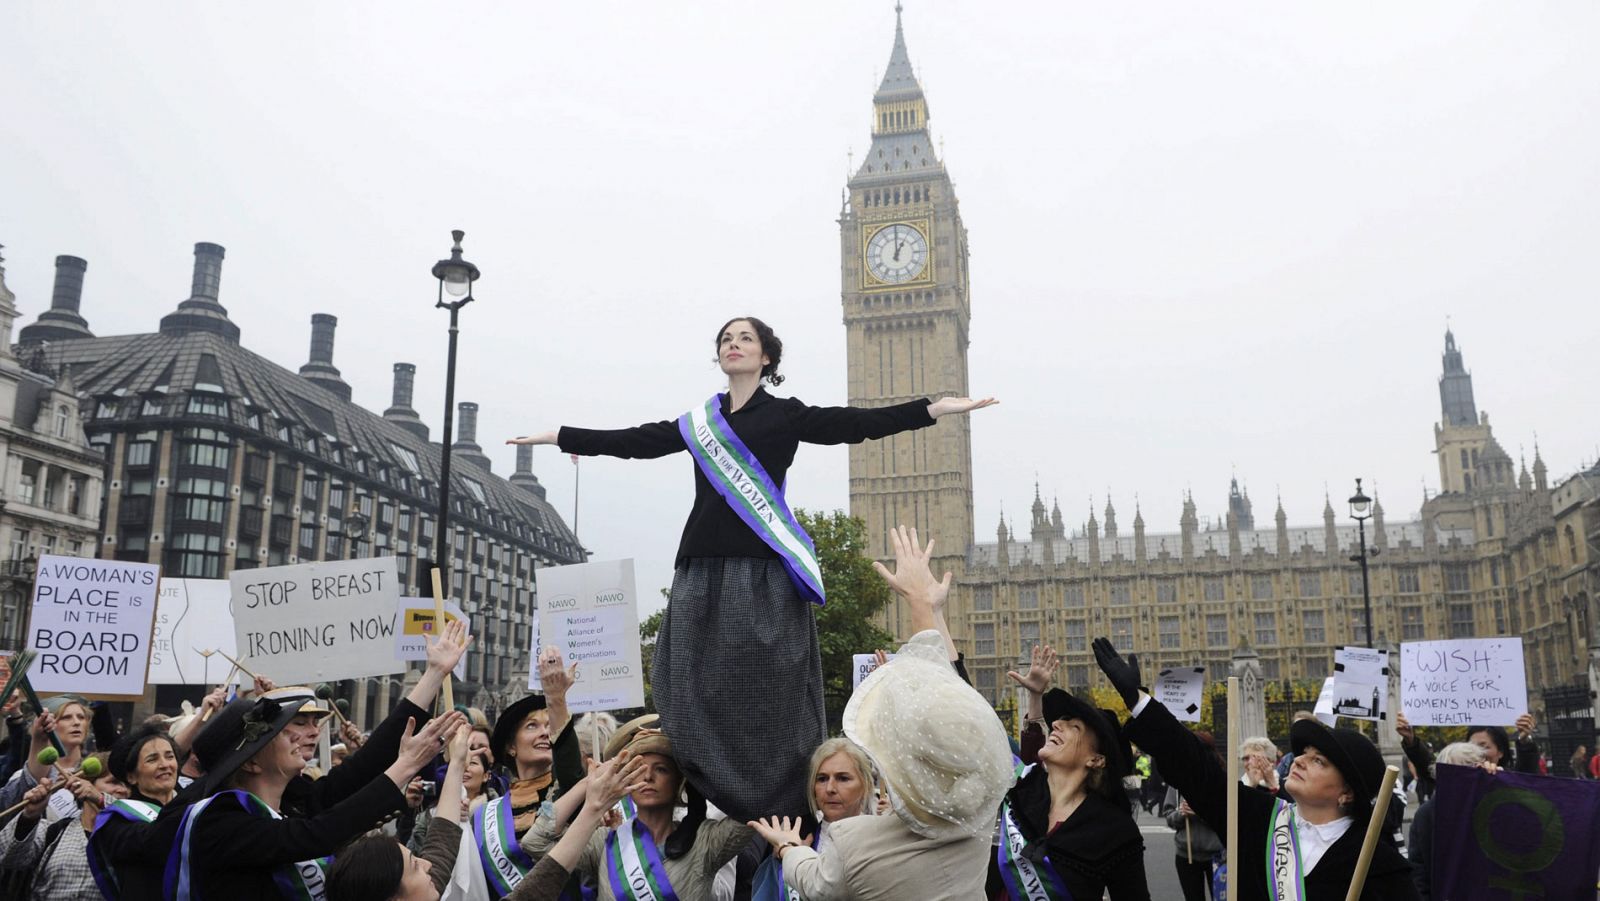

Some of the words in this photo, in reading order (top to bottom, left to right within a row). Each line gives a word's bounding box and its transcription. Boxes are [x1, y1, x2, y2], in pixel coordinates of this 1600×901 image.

[719, 455, 733, 472] FOR
[732, 468, 776, 525] WOMEN
[39, 567, 49, 577] A
[54, 564, 155, 585] WOMAN'S
[245, 580, 298, 608] STOP
[311, 570, 386, 601] BREAST
[36, 585, 120, 608] PLACE
[128, 596, 142, 607] IS
[548, 598, 577, 609] NAWO
[595, 592, 625, 604] NAWO
[64, 610, 80, 622] IN
[85, 611, 118, 624] THE
[567, 615, 597, 625] National
[247, 624, 336, 658] IRONING
[350, 612, 397, 643] NOW
[567, 628, 595, 637] Alliance
[596, 626, 604, 634] of
[35, 629, 139, 653] BOARD
[568, 638, 602, 648] Women's
[568, 649, 617, 661] Organisations
[1417, 649, 1491, 673] WISH
[40, 654, 129, 676] ROOM
[600, 666, 630, 677] NAWO
[1408, 680, 1417, 692] A
[1425, 680, 1459, 692] VOICE
[1470, 679, 1501, 691] FOR
[1404, 698, 1459, 710] WOMEN'S
[1466, 697, 1516, 710] MENTAL
[1431, 712, 1473, 725] HEALTH
[1018, 856, 1032, 876] FOR
[1277, 881, 1285, 901] FOR
